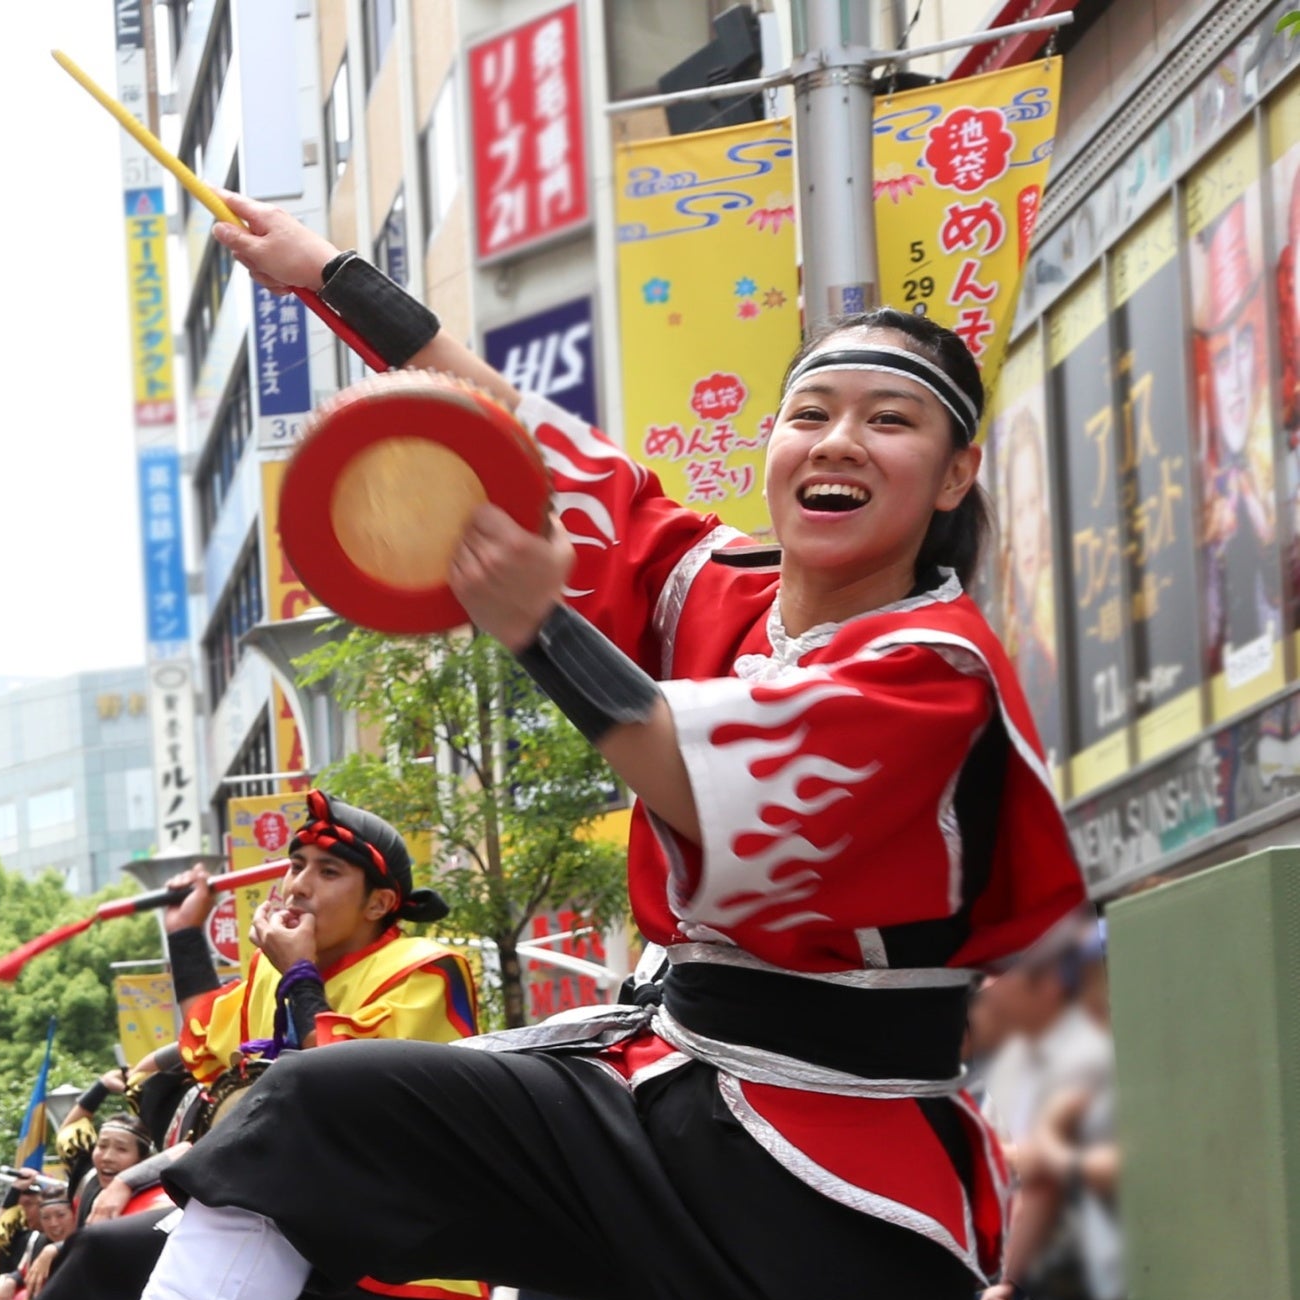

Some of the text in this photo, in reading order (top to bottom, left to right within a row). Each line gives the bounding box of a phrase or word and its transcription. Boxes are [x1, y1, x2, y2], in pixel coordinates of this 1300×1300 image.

[532, 16, 572, 228] 発毛専門
[949, 116, 989, 184] 池袋
[132, 218, 169, 398] エースコンタクト
[504, 321, 590, 396] HIS
[696, 387, 740, 410] 池袋
[687, 460, 753, 501] 祭り
